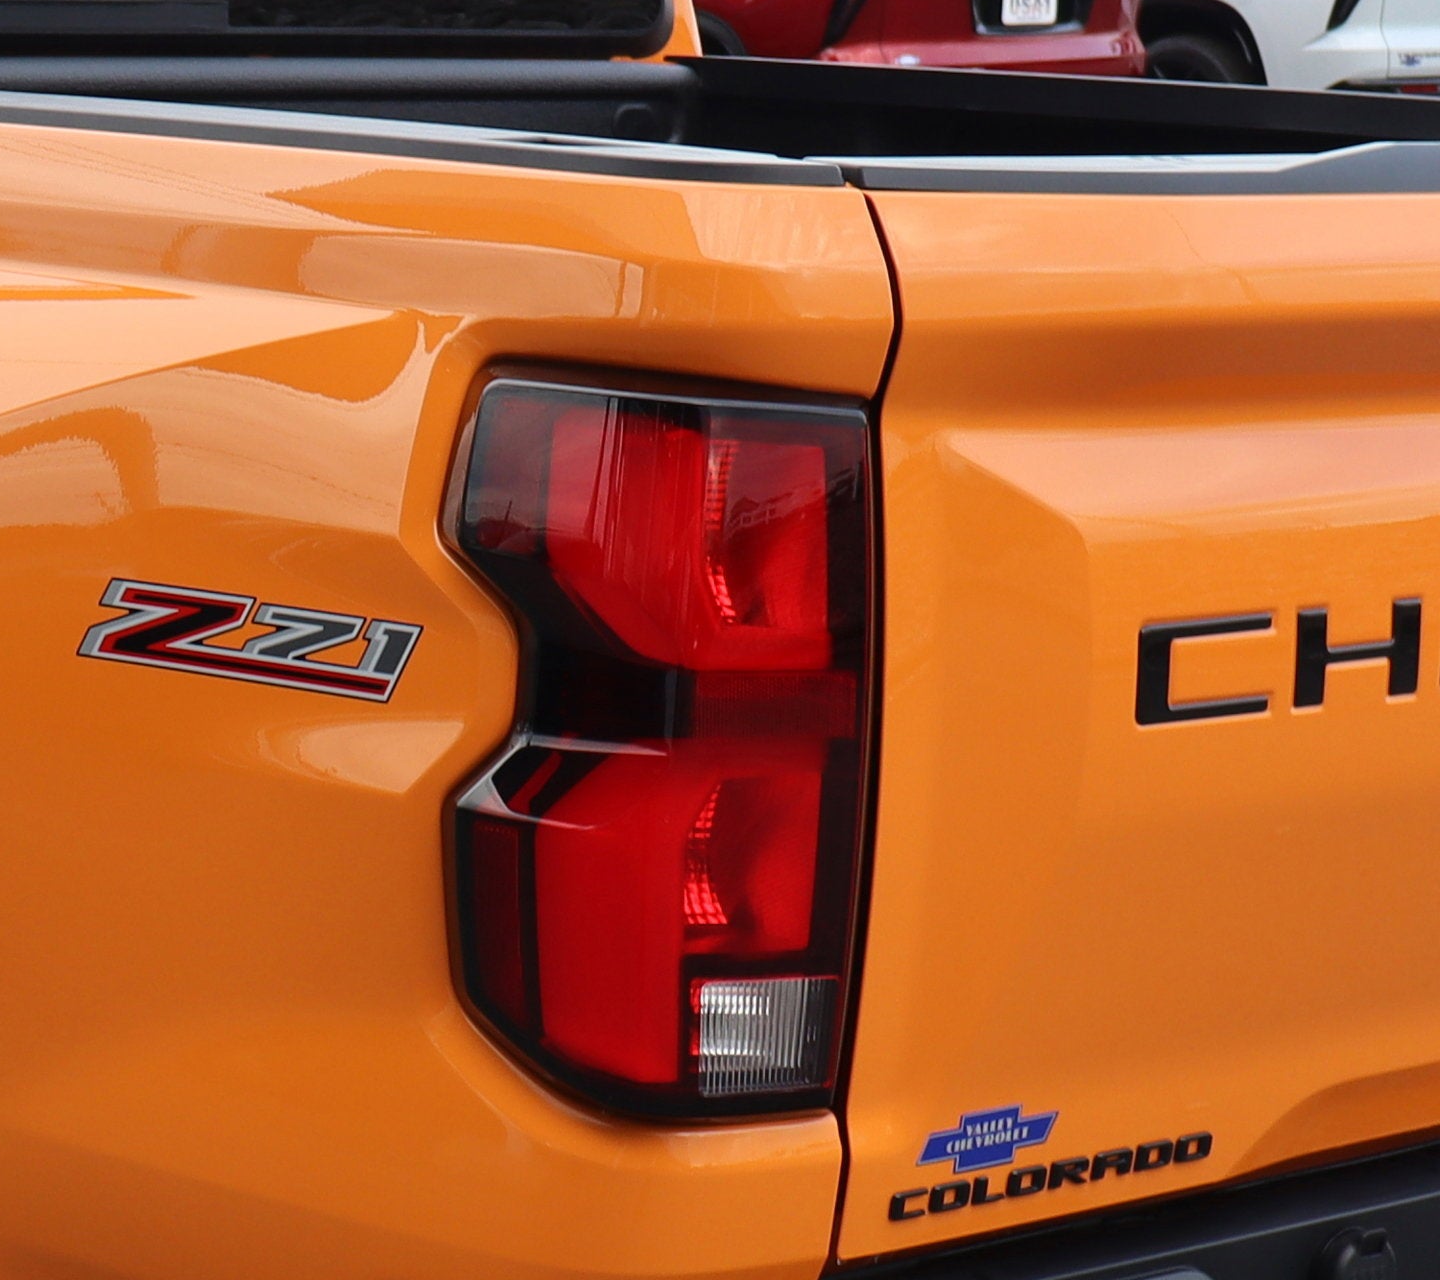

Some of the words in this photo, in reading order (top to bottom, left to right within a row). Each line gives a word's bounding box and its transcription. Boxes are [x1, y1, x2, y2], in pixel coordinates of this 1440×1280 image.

[76, 577, 424, 703] Z71
[946, 1125, 1029, 1154] CHEVROLET
[965, 1117, 1014, 1137] VALLEY
[888, 1131, 1213, 1222] COLORADO
